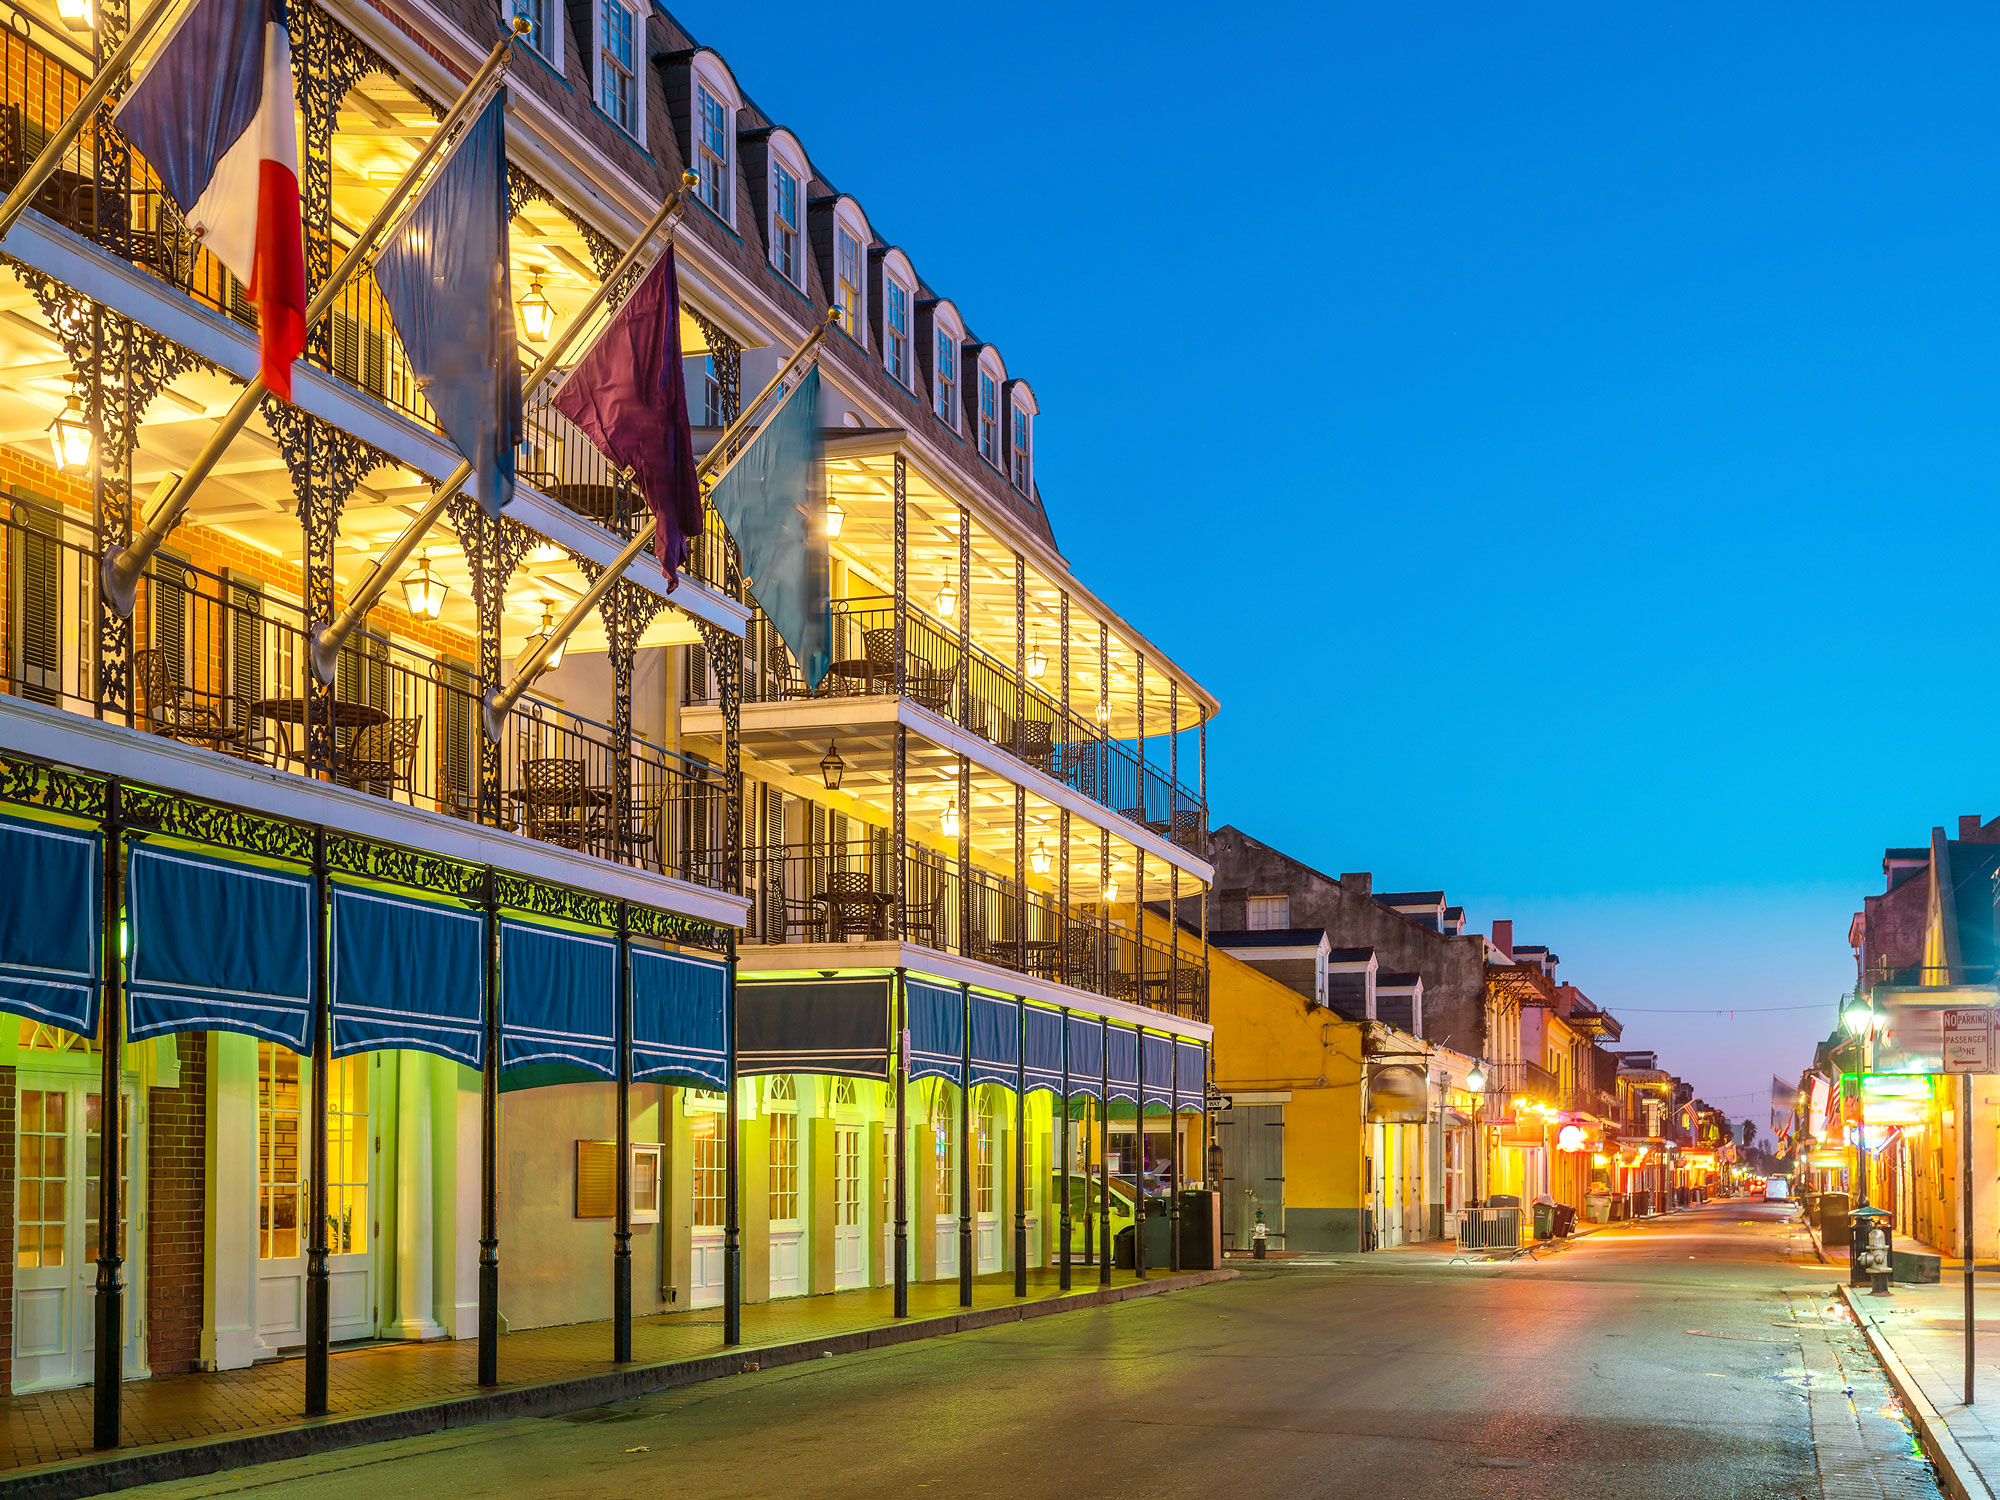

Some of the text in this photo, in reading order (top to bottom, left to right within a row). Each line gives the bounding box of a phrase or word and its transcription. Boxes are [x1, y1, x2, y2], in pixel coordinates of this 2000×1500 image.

[1944, 1014, 1987, 1027] NO PARKING
[1946, 1036, 1986, 1044] PASSENGER
